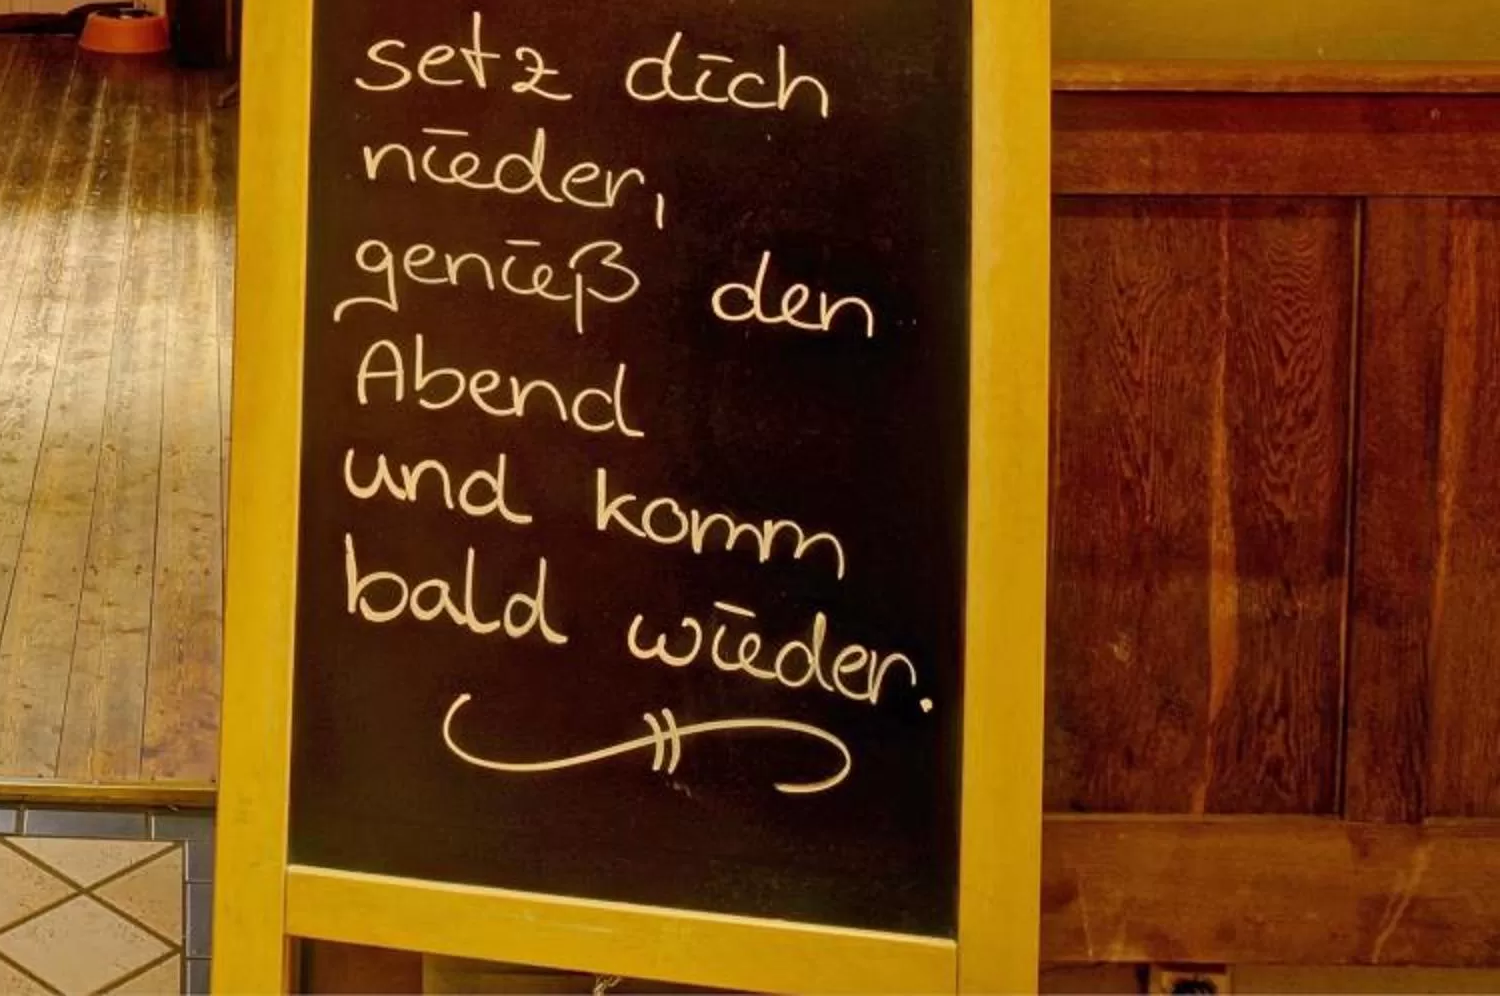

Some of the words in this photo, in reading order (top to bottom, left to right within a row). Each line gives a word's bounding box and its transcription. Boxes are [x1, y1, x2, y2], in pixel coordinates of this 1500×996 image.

[354, 11, 573, 102] setz
[624, 32, 829, 118] dich
[362, 126, 665, 230] nieder,
[332, 237, 641, 334] genieß
[710, 250, 875, 338] den
[355, 332, 645, 437] Abend
[342, 448, 533, 525] und
[596, 467, 845, 580] komm
[344, 532, 568, 646] bald
[627, 600, 934, 714] wieder.
